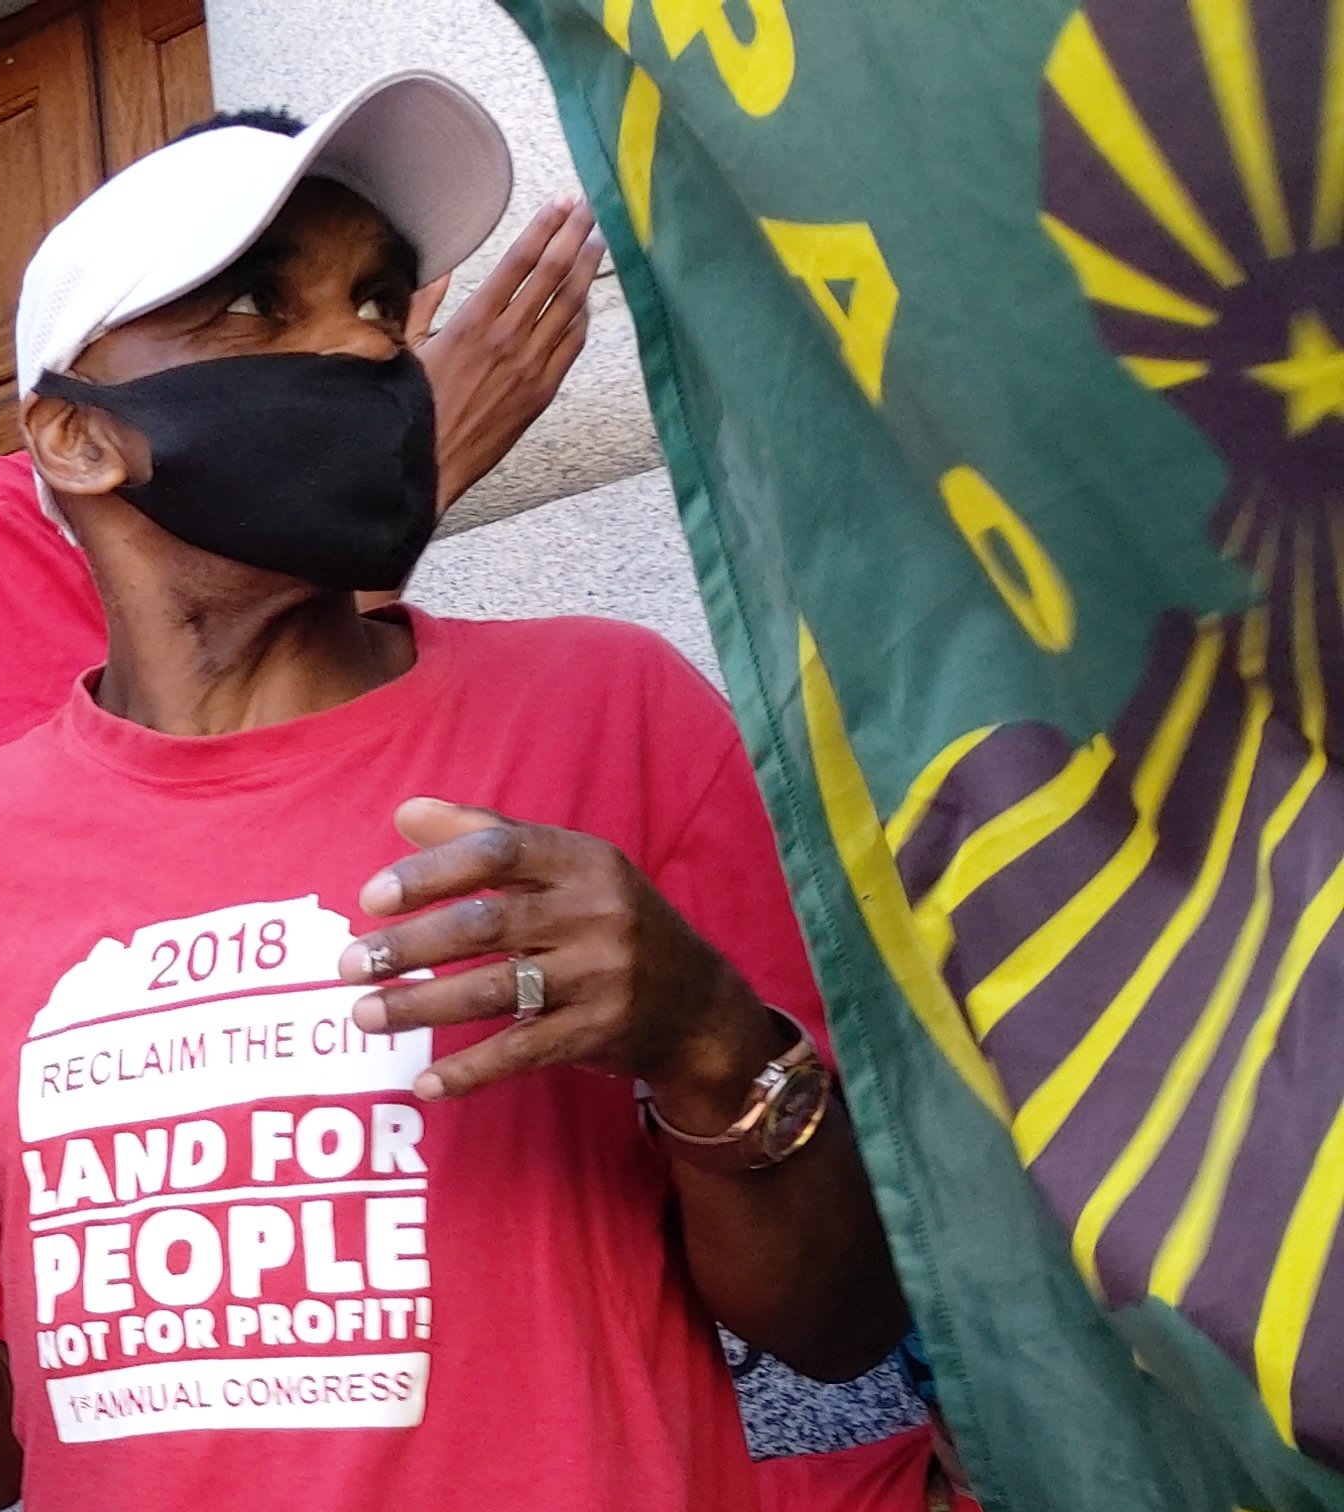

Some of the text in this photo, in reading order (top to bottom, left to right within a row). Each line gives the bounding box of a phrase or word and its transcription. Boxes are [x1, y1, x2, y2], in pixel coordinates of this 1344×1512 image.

[146, 919, 288, 991] 2018
[40, 1028, 208, 1099] RECLAIM
[222, 1020, 294, 1064] THE
[22, 1103, 428, 1215] LAND FOR
[31, 1196, 431, 1324] PEOPLE
[37, 1297, 433, 1370] NOT FOR PROFIT!
[93, 1381, 212, 1421] ANNUAL
[221, 1371, 416, 1408] CONGRESS
